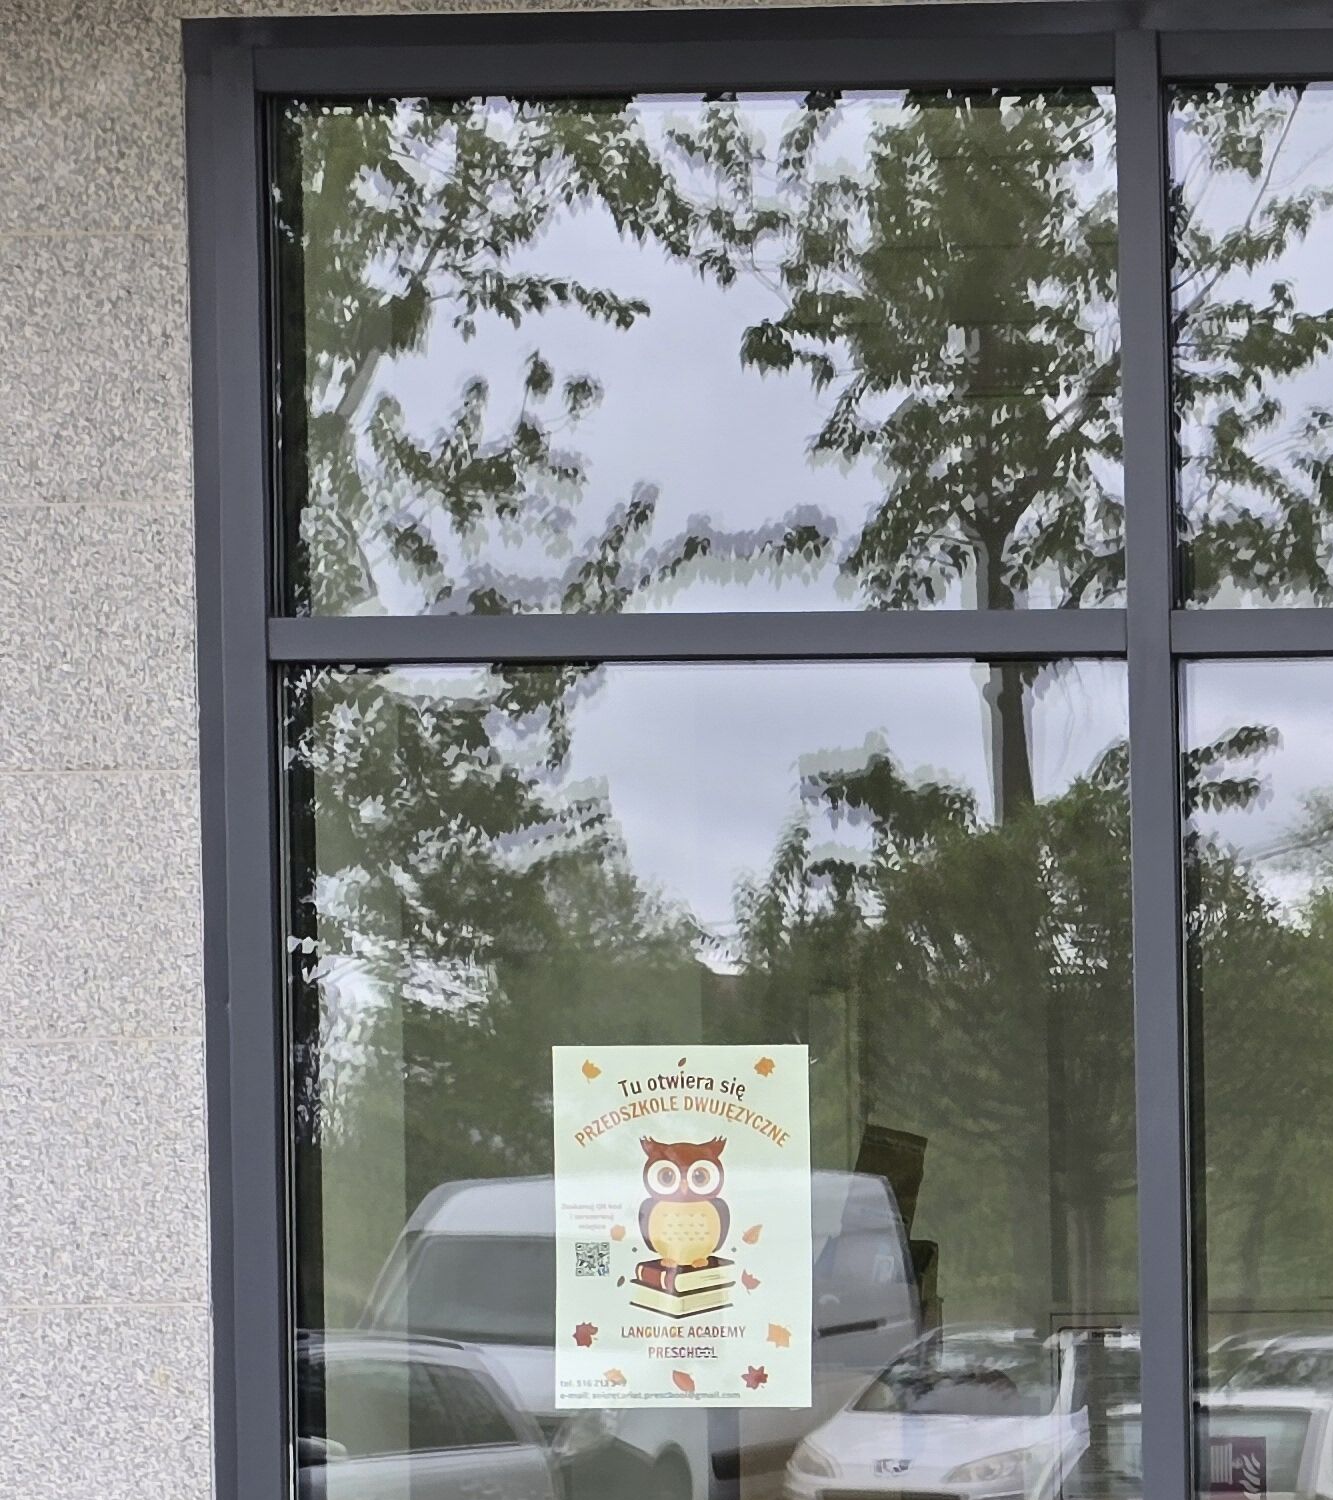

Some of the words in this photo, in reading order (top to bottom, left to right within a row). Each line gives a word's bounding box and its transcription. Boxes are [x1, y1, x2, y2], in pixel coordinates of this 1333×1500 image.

[618, 1079, 642, 1097] Tu
[647, 1071, 714, 1091] otwiera
[720, 1077, 746, 1100] się
[574, 1096, 678, 1147] PRZEDSZKOLE
[684, 1096, 790, 1147] DWUJĘZYCZNE
[621, 1326, 684, 1338] LANGUAGE
[687, 1326, 746, 1338] ACADEMY
[648, 1347, 718, 1358] PRESCHOOL
